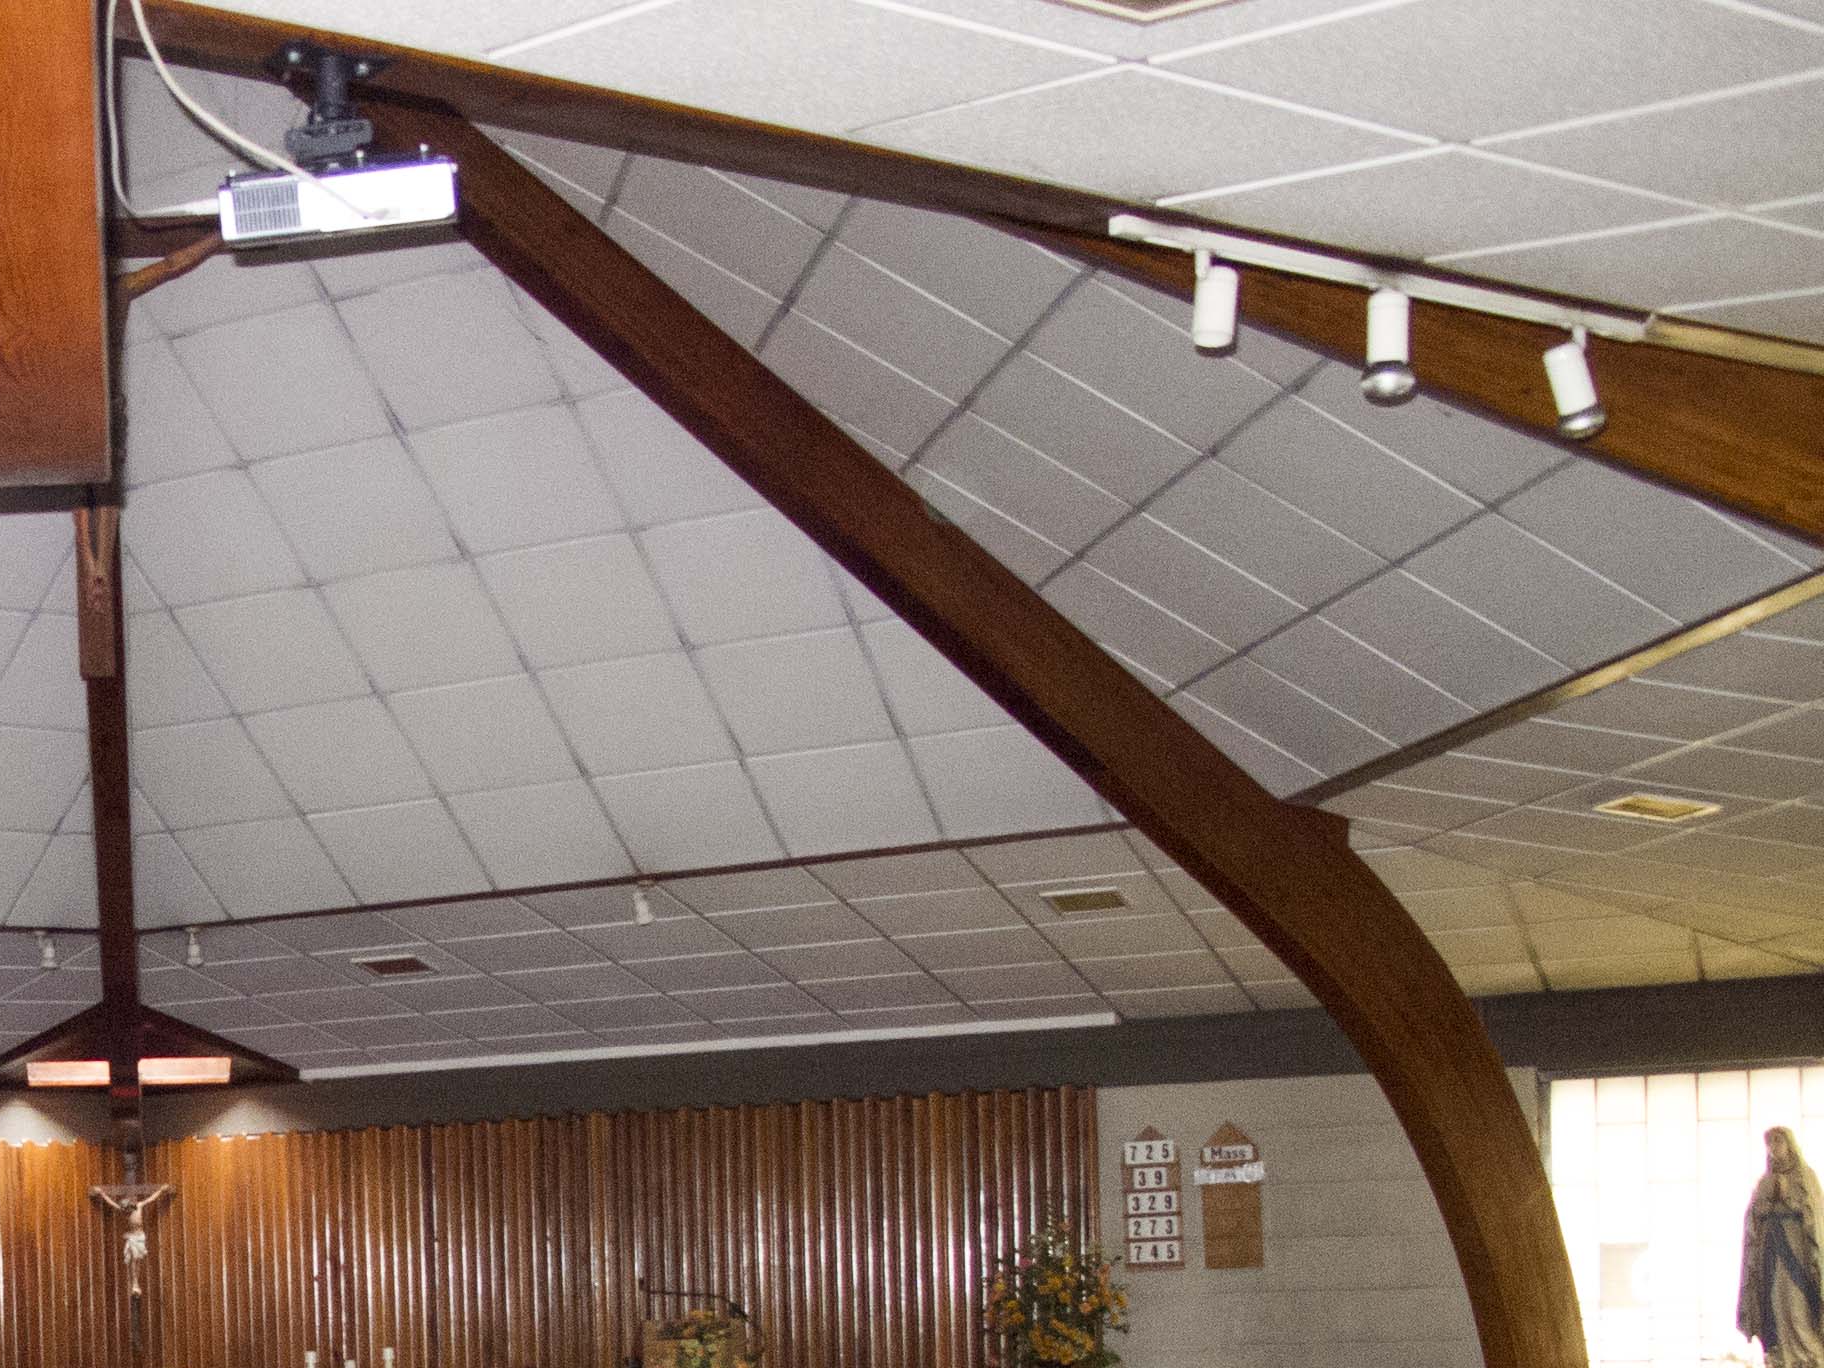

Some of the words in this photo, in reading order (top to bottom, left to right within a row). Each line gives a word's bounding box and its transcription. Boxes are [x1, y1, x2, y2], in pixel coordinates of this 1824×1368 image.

[1129, 1144, 1170, 1161] 725
[1210, 1146, 1246, 1160] Mass
[1138, 1171, 1163, 1186] 39
[1132, 1195, 1173, 1212] 329
[1133, 1219, 1174, 1236] 273
[1134, 1243, 1175, 1261] 745
